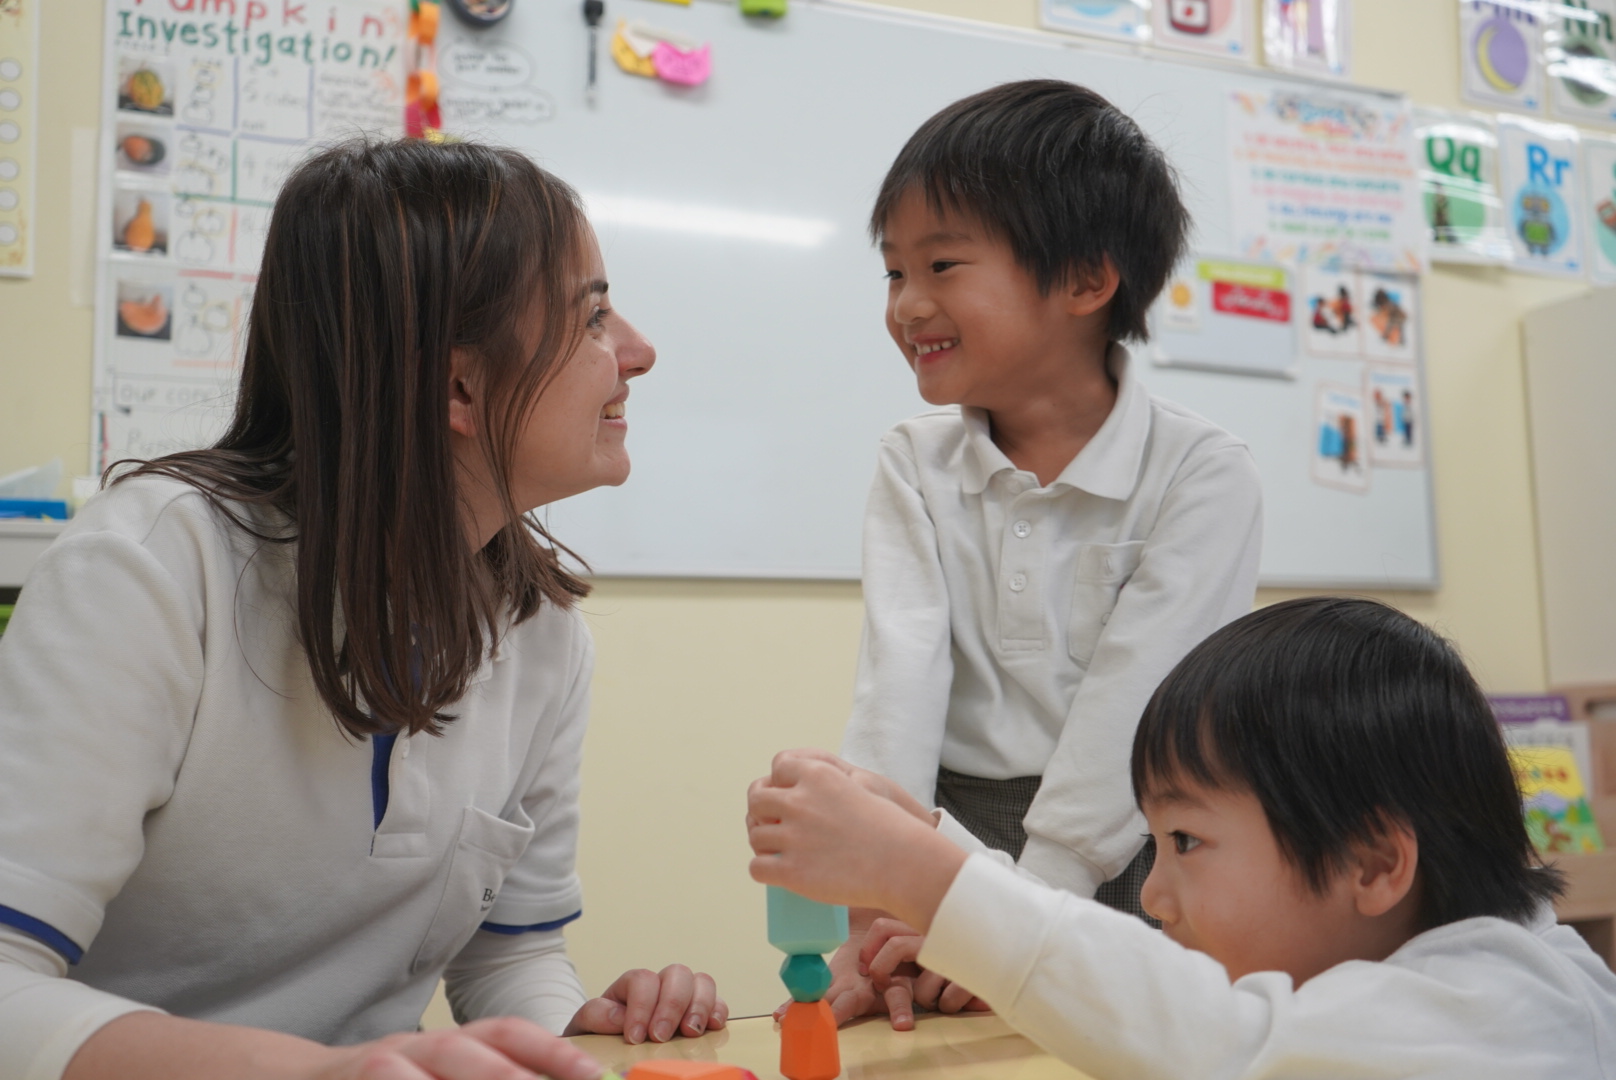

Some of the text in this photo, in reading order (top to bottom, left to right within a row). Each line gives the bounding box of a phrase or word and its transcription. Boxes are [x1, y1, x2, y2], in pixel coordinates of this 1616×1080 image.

[117, 10, 396, 68] Investigation!
[135, 0, 384, 37] umpkin
[1426, 135, 1482, 183] Qq
[1526, 142, 1571, 186] Rr
